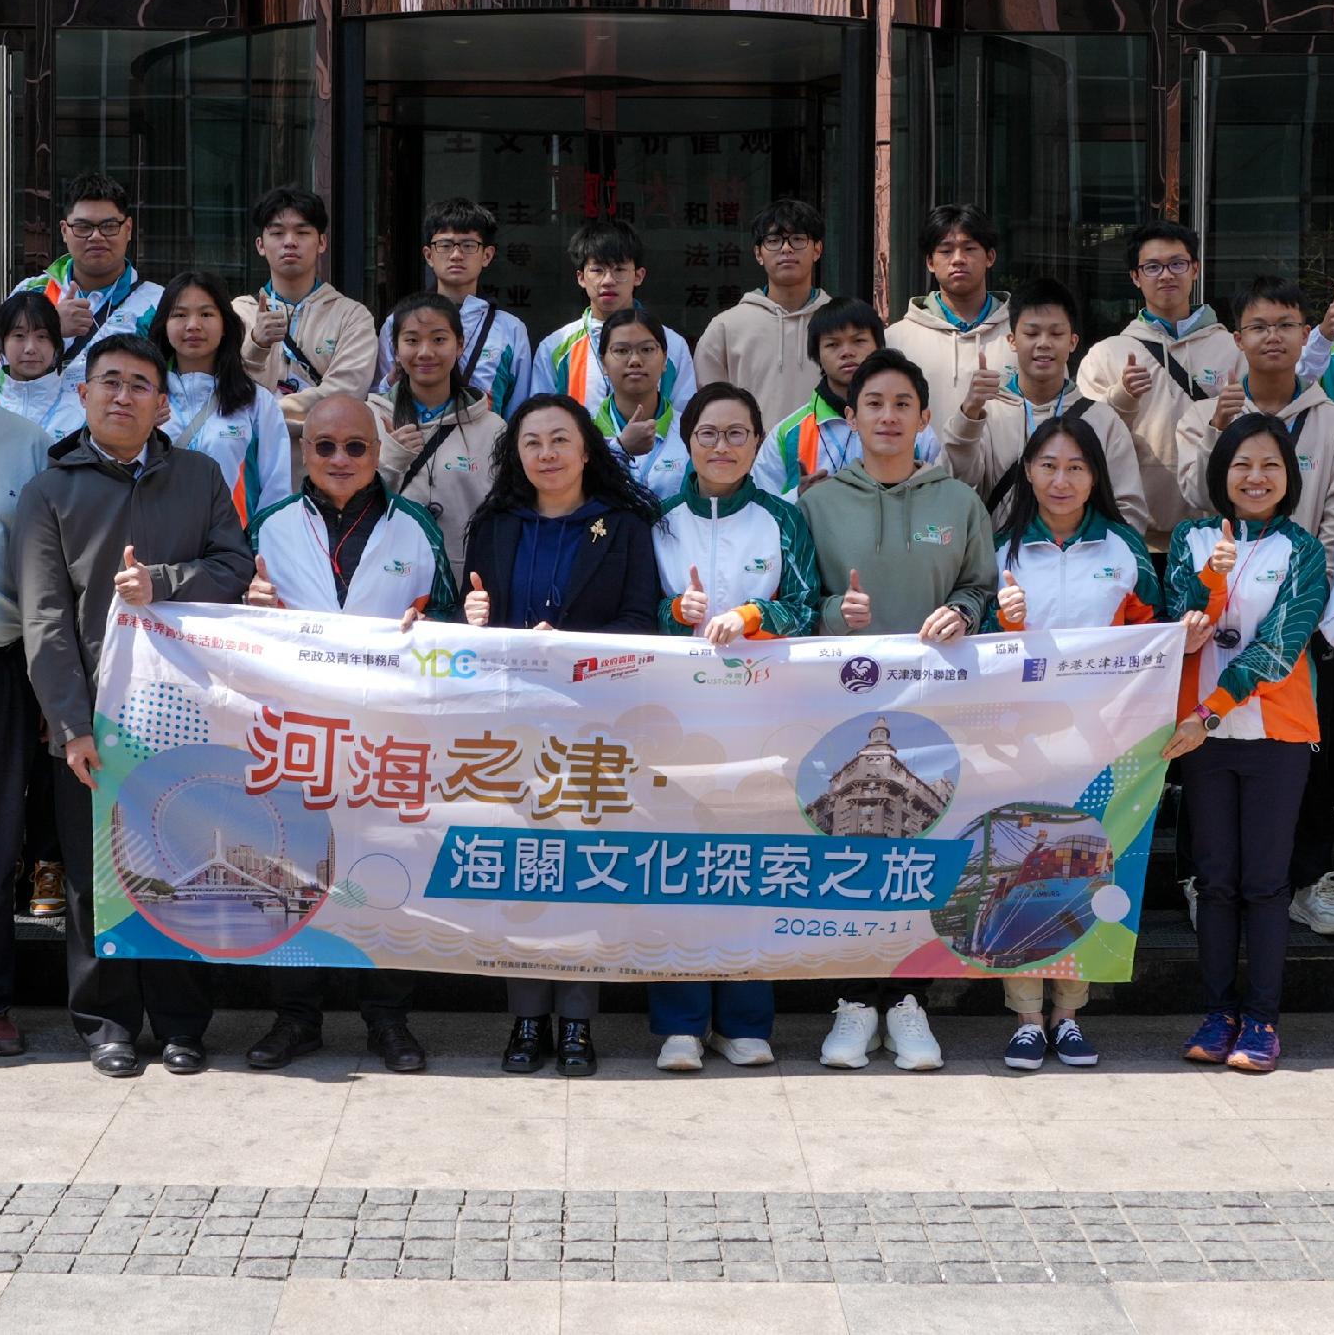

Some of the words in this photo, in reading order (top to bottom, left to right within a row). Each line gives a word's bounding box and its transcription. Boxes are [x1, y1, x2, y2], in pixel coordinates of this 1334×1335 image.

[684, 243, 741, 267] 法治
[299, 622, 323, 635] 資助
[819, 647, 842, 658] 支持
[995, 642, 1018, 655] 協辦
[298, 649, 400, 668] 民政及青年事務局
[412, 648, 478, 680] YDC
[1058, 651, 1168, 672] 香港天津社團總會
[887, 667, 967, 682] 天津海外聯誼會
[450, 834, 936, 902] 海關文化探索之旅
